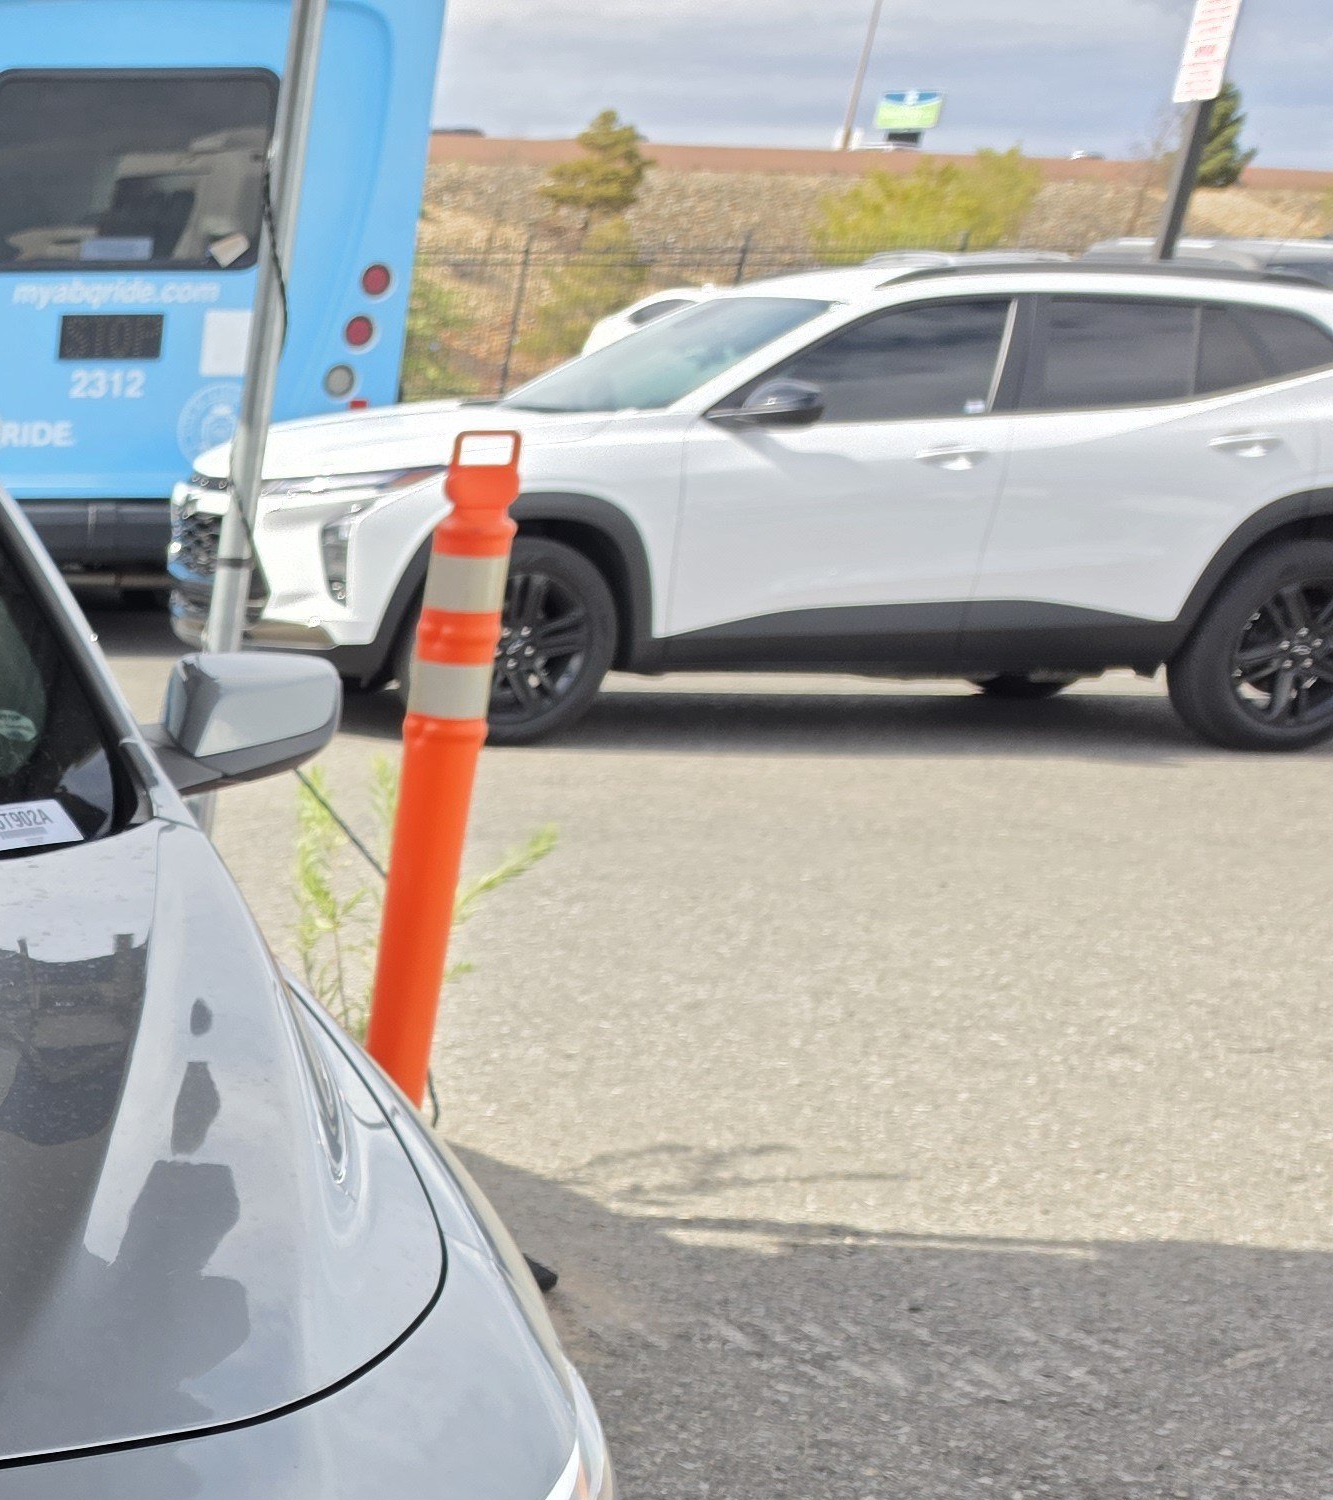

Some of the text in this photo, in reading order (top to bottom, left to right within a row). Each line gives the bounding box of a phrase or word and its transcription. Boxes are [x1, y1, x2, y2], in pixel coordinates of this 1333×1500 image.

[13, 278, 220, 309] myabqride.com
[69, 369, 145, 399] 2312
[0, 420, 75, 447] RIDE
